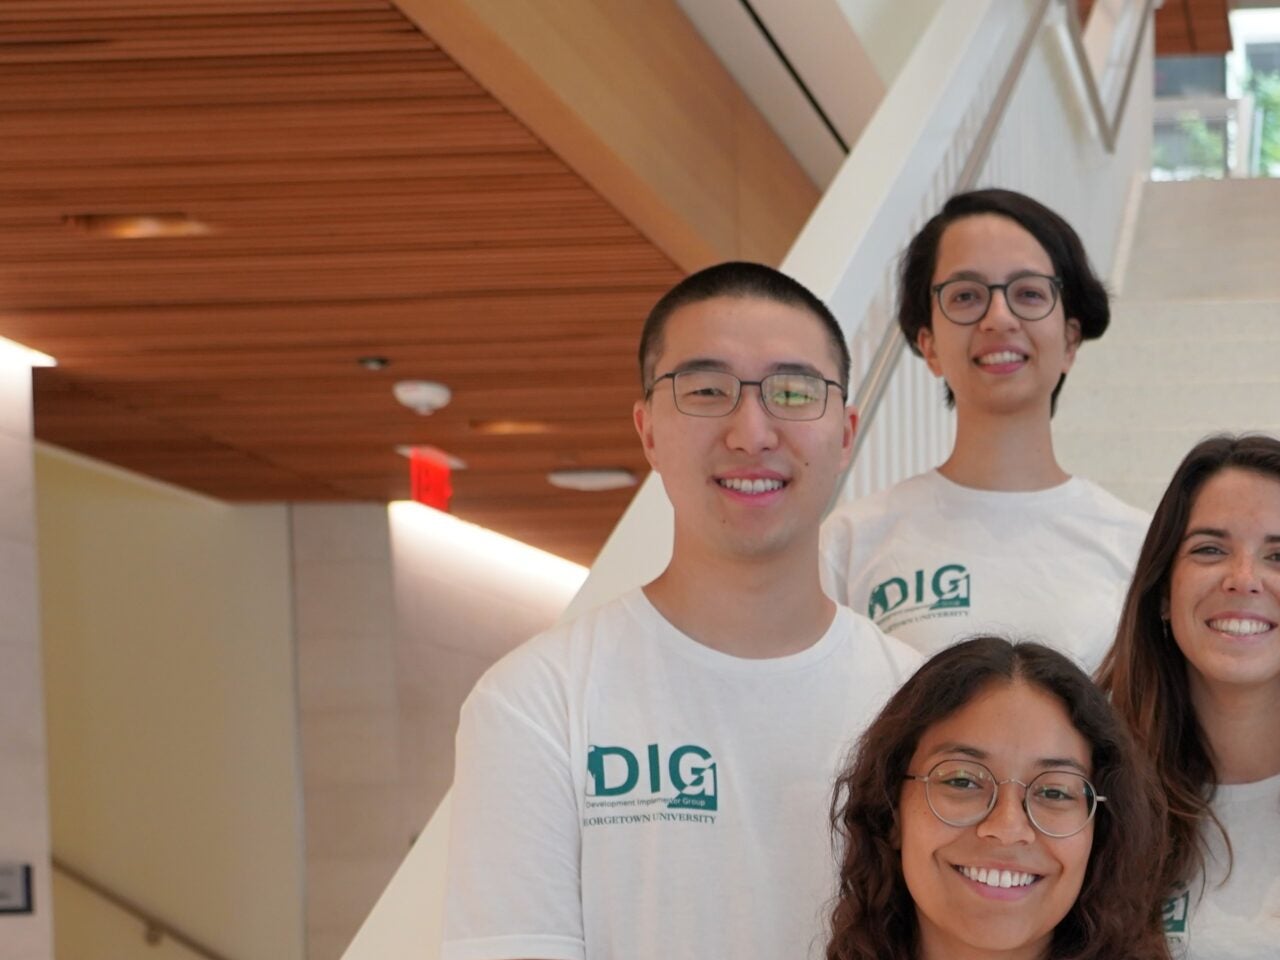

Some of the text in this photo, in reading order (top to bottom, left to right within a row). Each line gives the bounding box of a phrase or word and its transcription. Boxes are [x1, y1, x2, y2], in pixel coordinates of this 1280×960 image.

[867, 564, 970, 619] DIG
[585, 743, 717, 804] DIG
[582, 812, 717, 827] EORGETOWN UNIVERSITY
[585, 798, 636, 809] Development
[682, 797, 706, 807] Group
